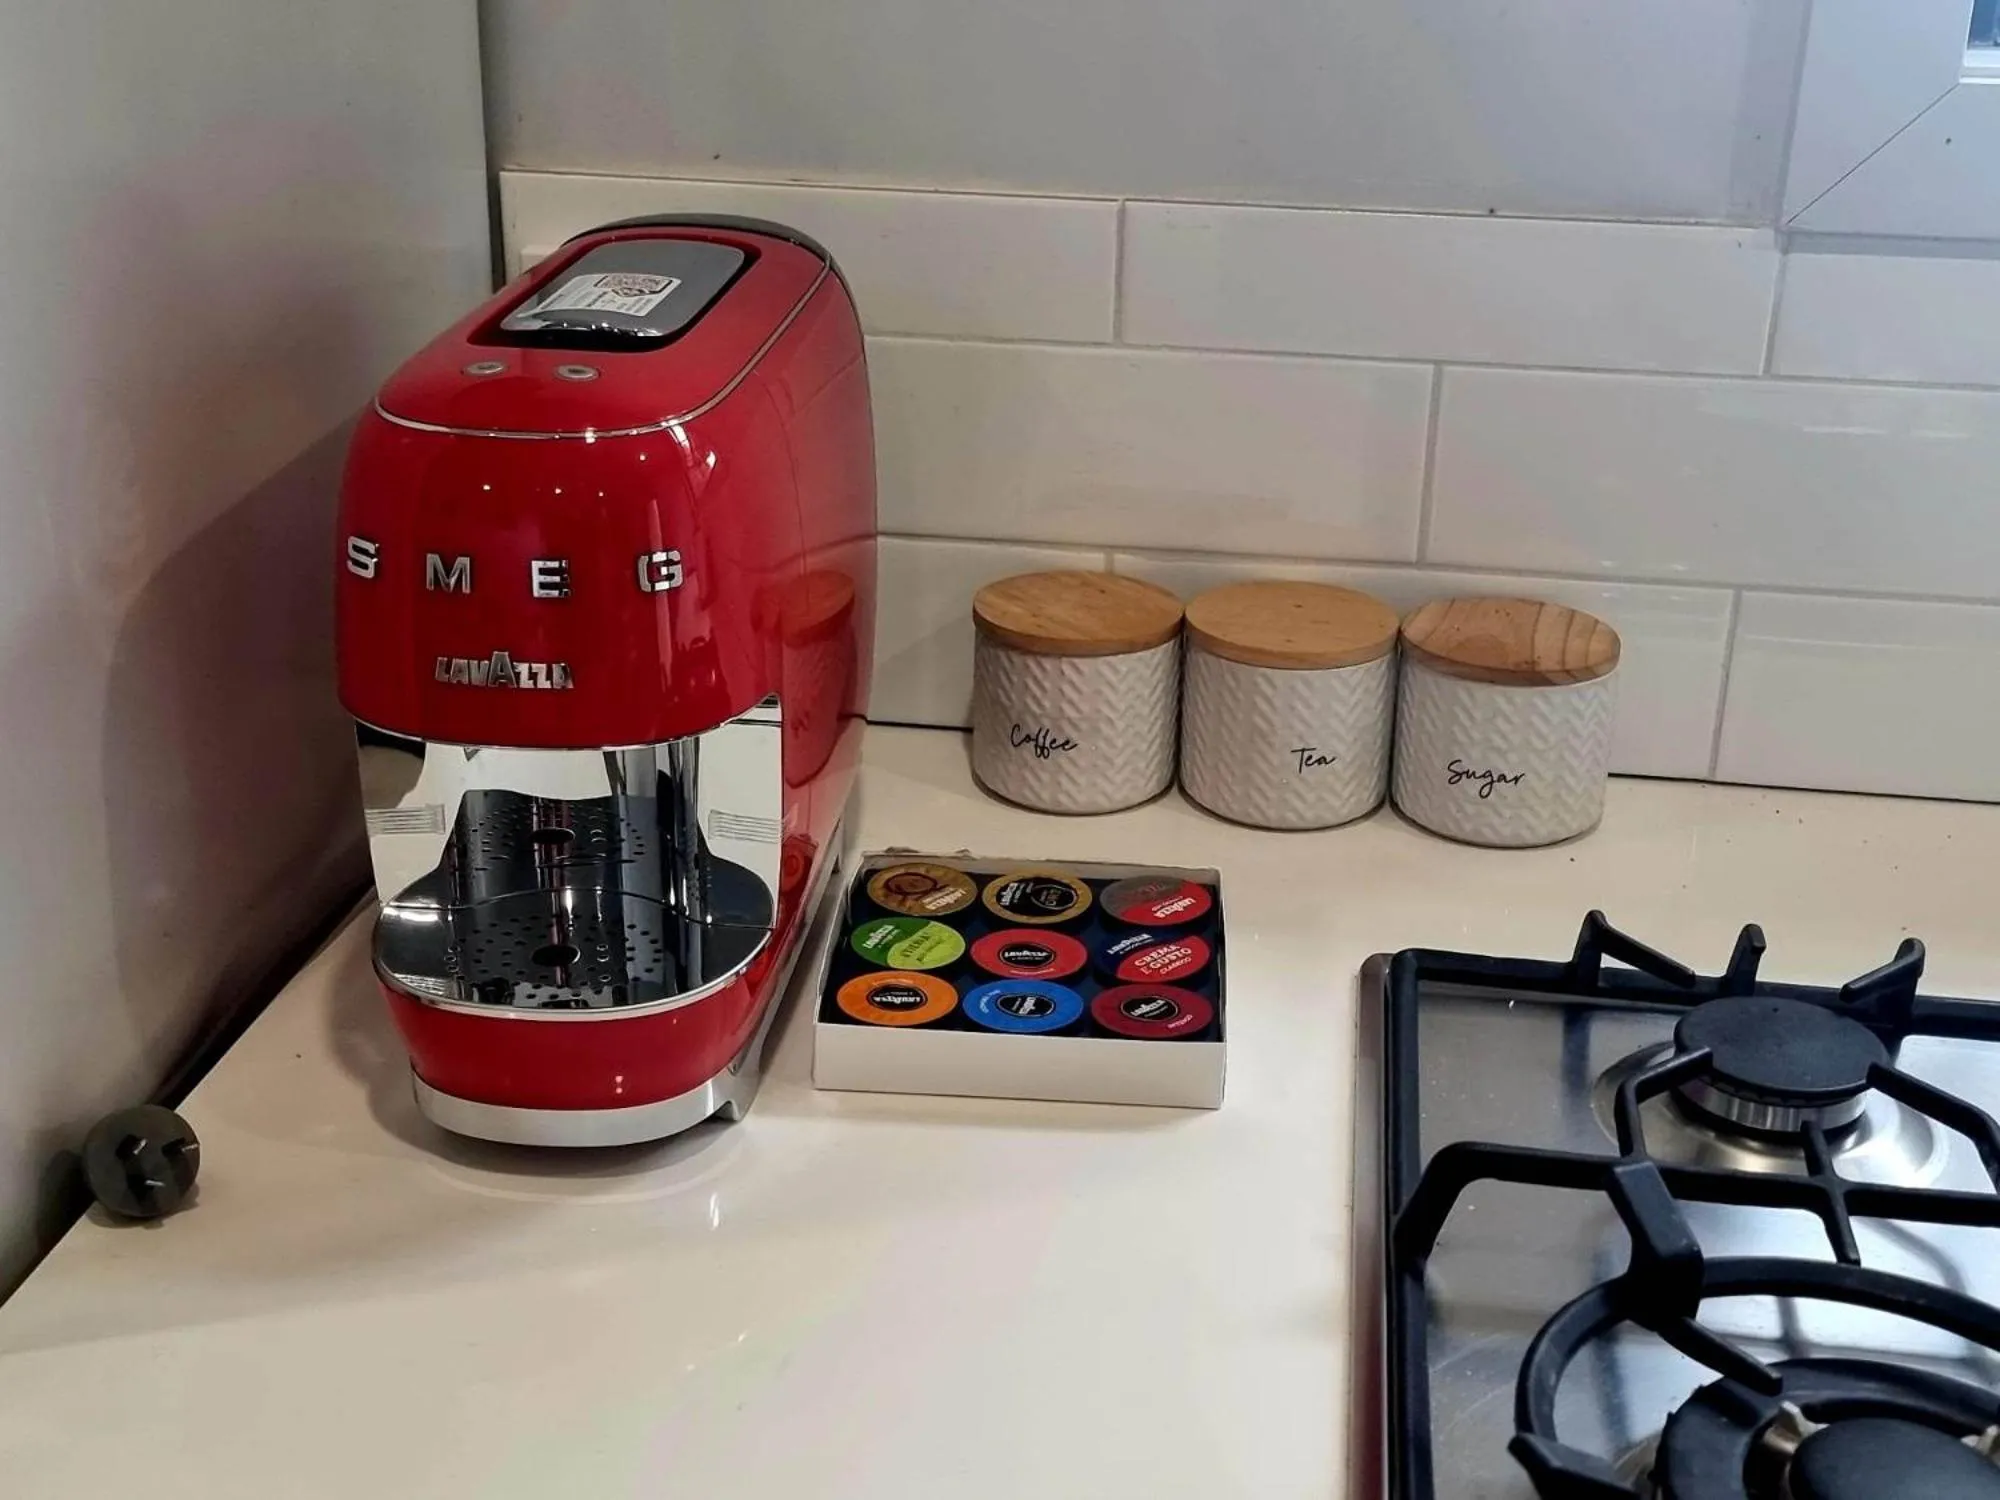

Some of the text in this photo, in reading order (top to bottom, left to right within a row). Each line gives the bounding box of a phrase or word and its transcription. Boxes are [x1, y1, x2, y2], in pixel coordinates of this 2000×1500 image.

[347, 535, 684, 598] SMEG
[435, 651, 574, 689] LAVAZZA
[1010, 723, 1079, 759] Coffee
[1290, 747, 1338, 774] Tea
[1447, 759, 1526, 799] Sugar
[1134, 944, 1180, 967] CREMA
[1149, 947, 1193, 969] GUSTO
